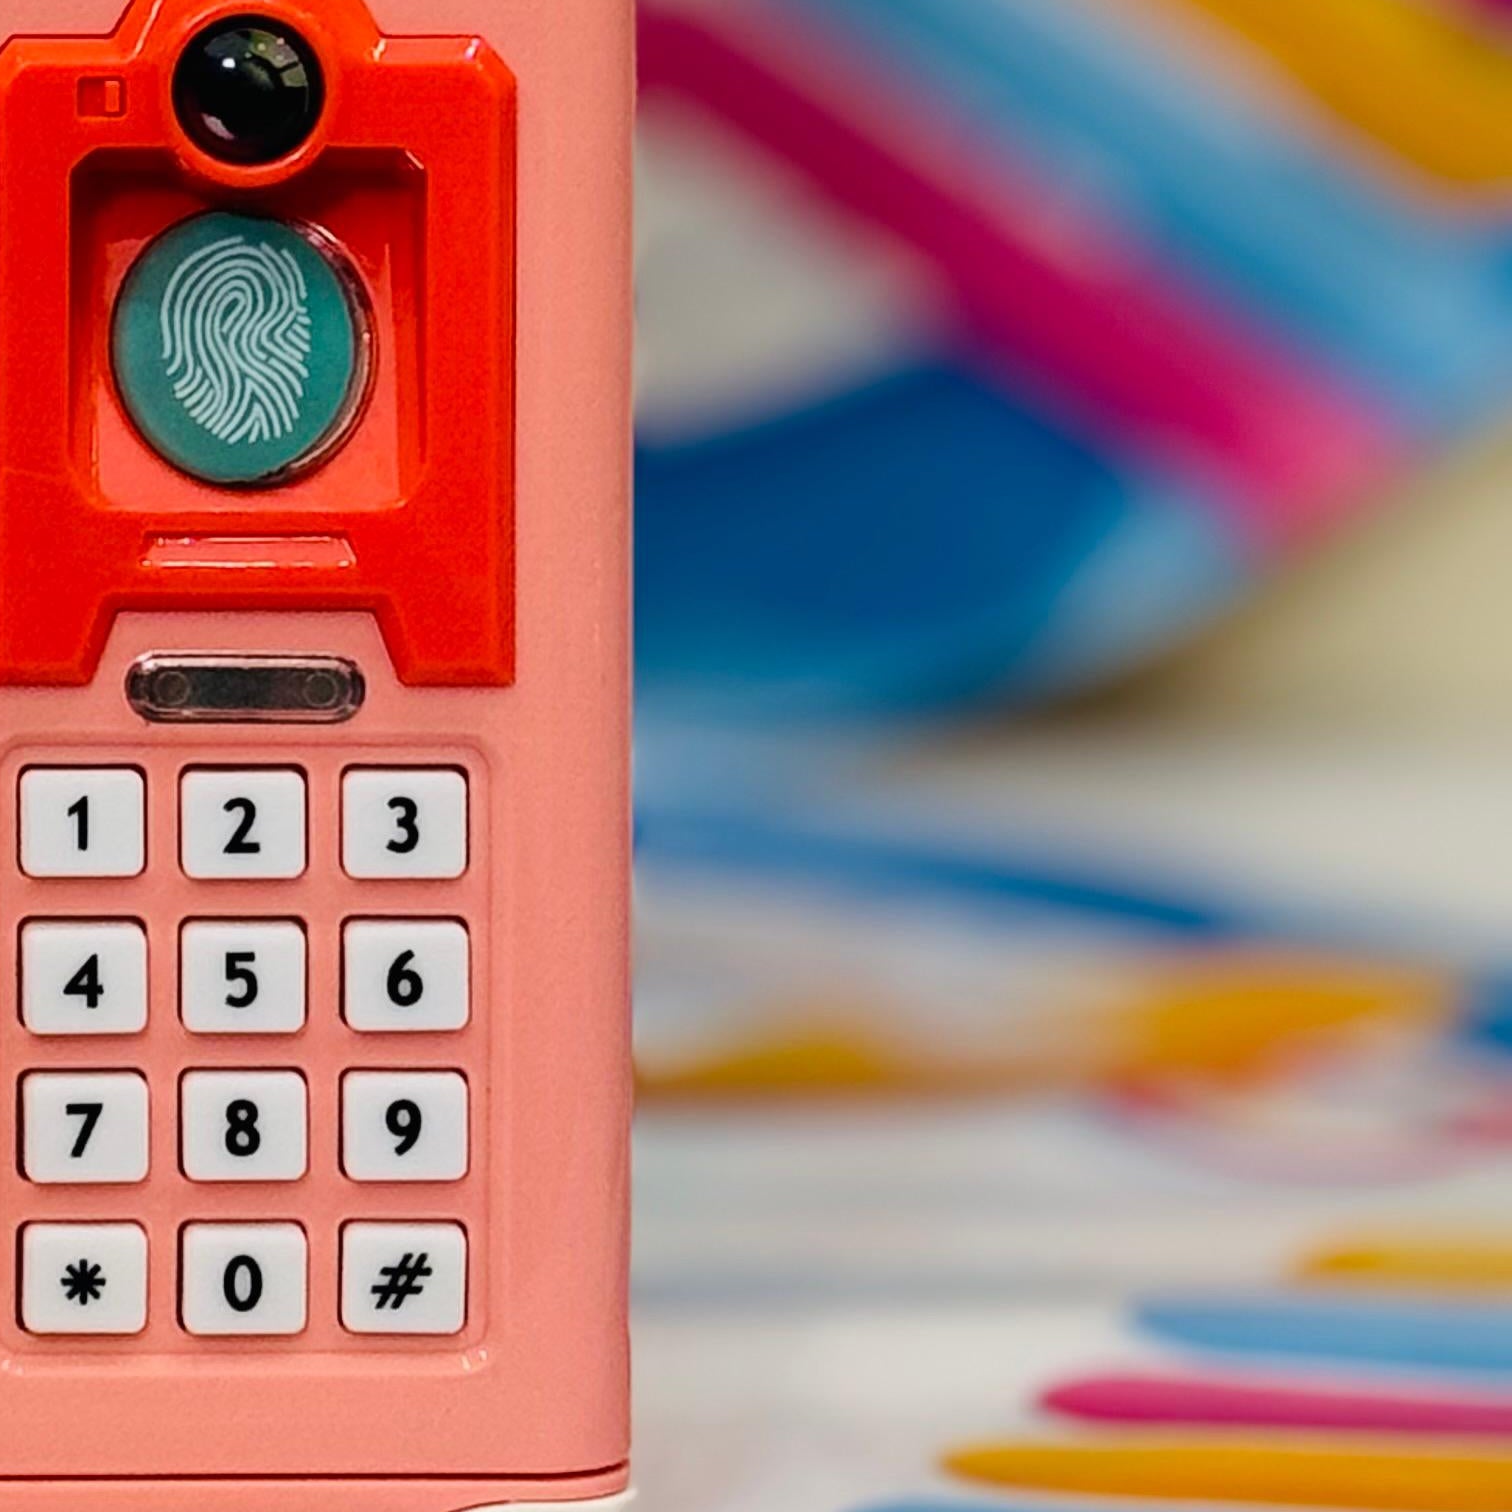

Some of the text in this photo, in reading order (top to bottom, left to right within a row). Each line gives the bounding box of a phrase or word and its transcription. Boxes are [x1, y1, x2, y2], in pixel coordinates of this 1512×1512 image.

[66, 794, 420, 855] 1 2 3
[62, 949, 424, 1009] 4 5 6
[64, 1098, 423, 1159] 7 8 9
[222, 1253, 264, 1313] 0
[370, 1252, 434, 1310] #
